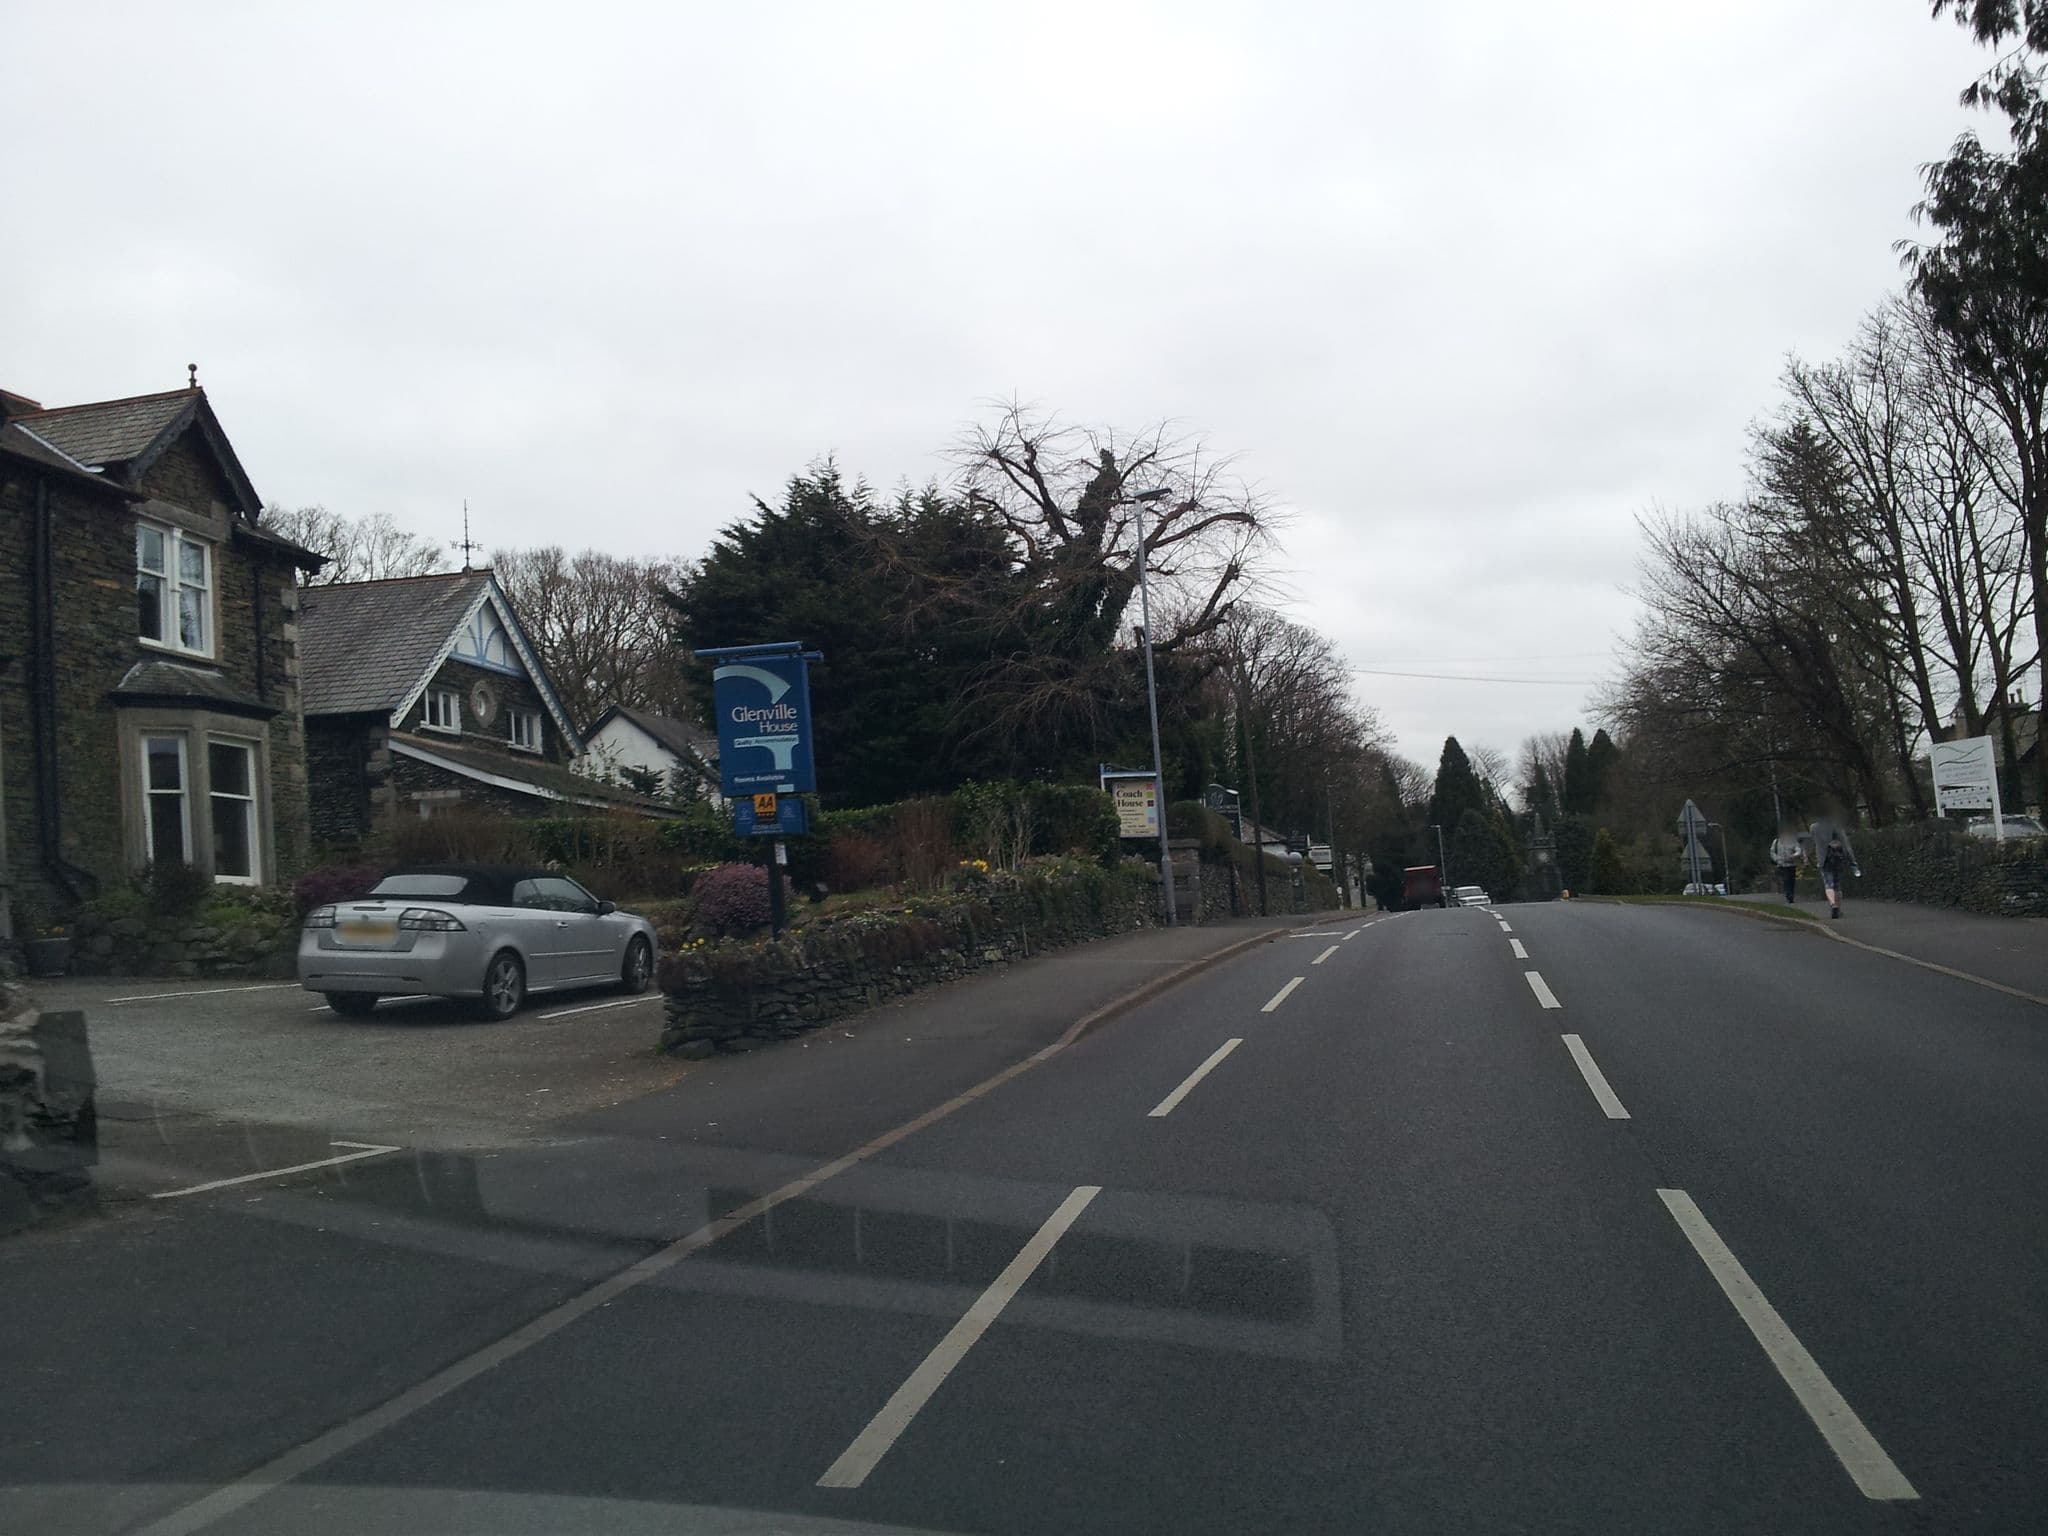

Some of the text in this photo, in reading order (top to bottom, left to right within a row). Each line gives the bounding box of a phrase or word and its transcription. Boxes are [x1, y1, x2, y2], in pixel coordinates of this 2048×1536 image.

[732, 704, 797, 722] Glenville
[759, 721, 798, 733] House
[1116, 790, 1143, 798] Coach
[758, 796, 774, 809] AA
[1117, 799, 1144, 807] House
